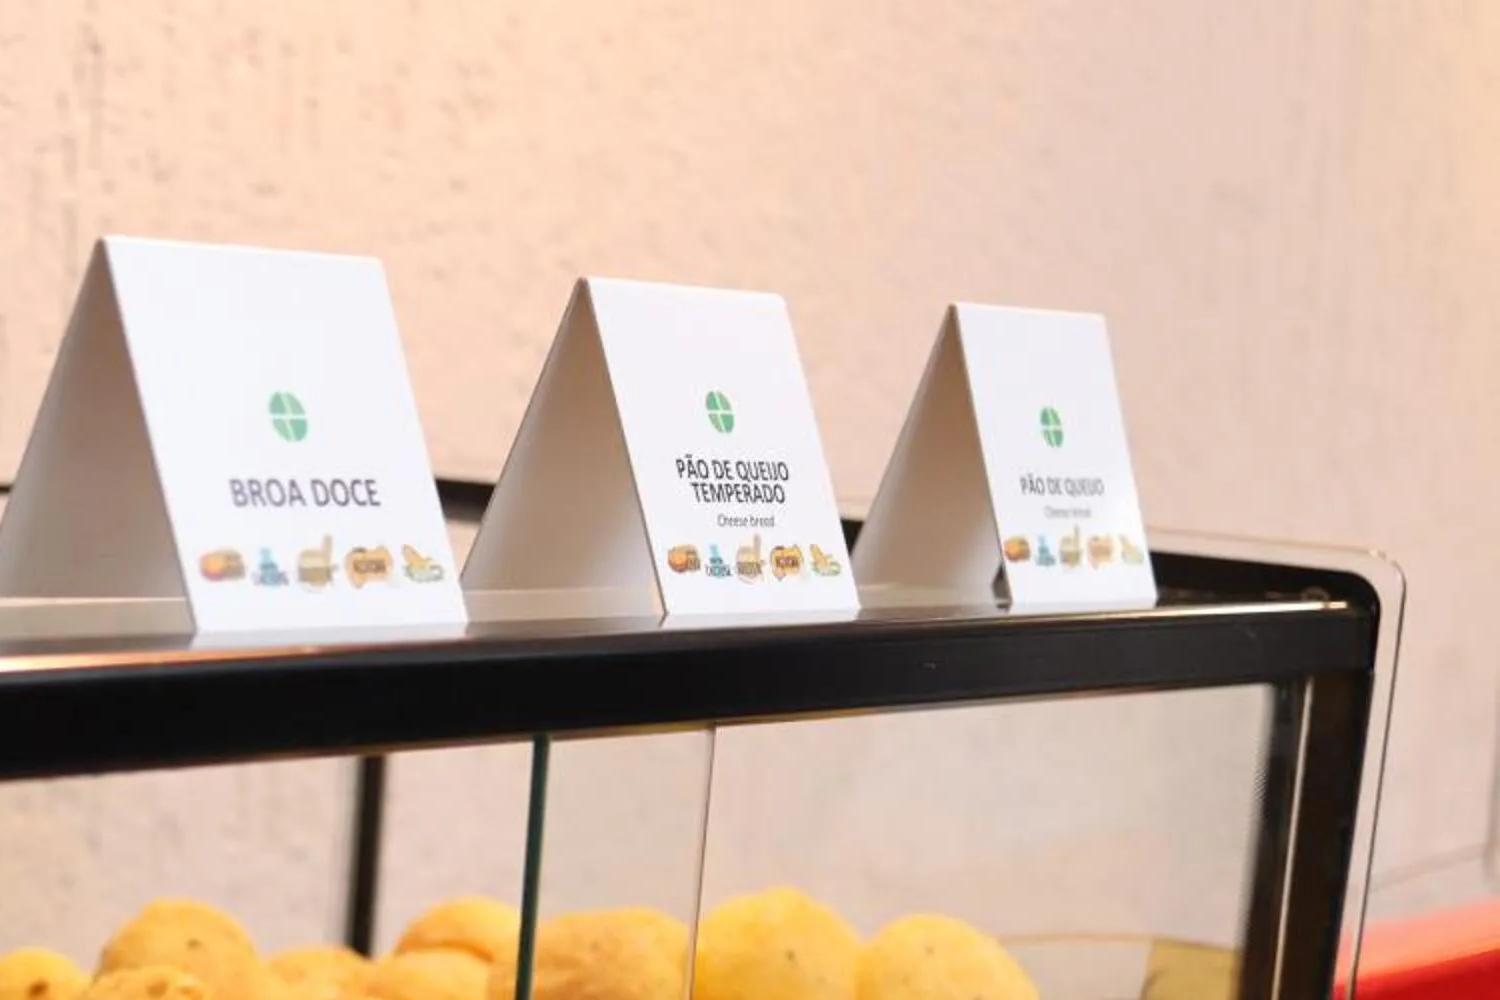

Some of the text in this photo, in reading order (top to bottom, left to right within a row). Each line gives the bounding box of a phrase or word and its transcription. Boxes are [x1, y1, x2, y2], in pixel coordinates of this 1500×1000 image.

[676, 454, 789, 482] PÃO DE QUEIJO
[229, 478, 381, 507] BROA DOCE
[691, 482, 785, 504] TEMPERADO
